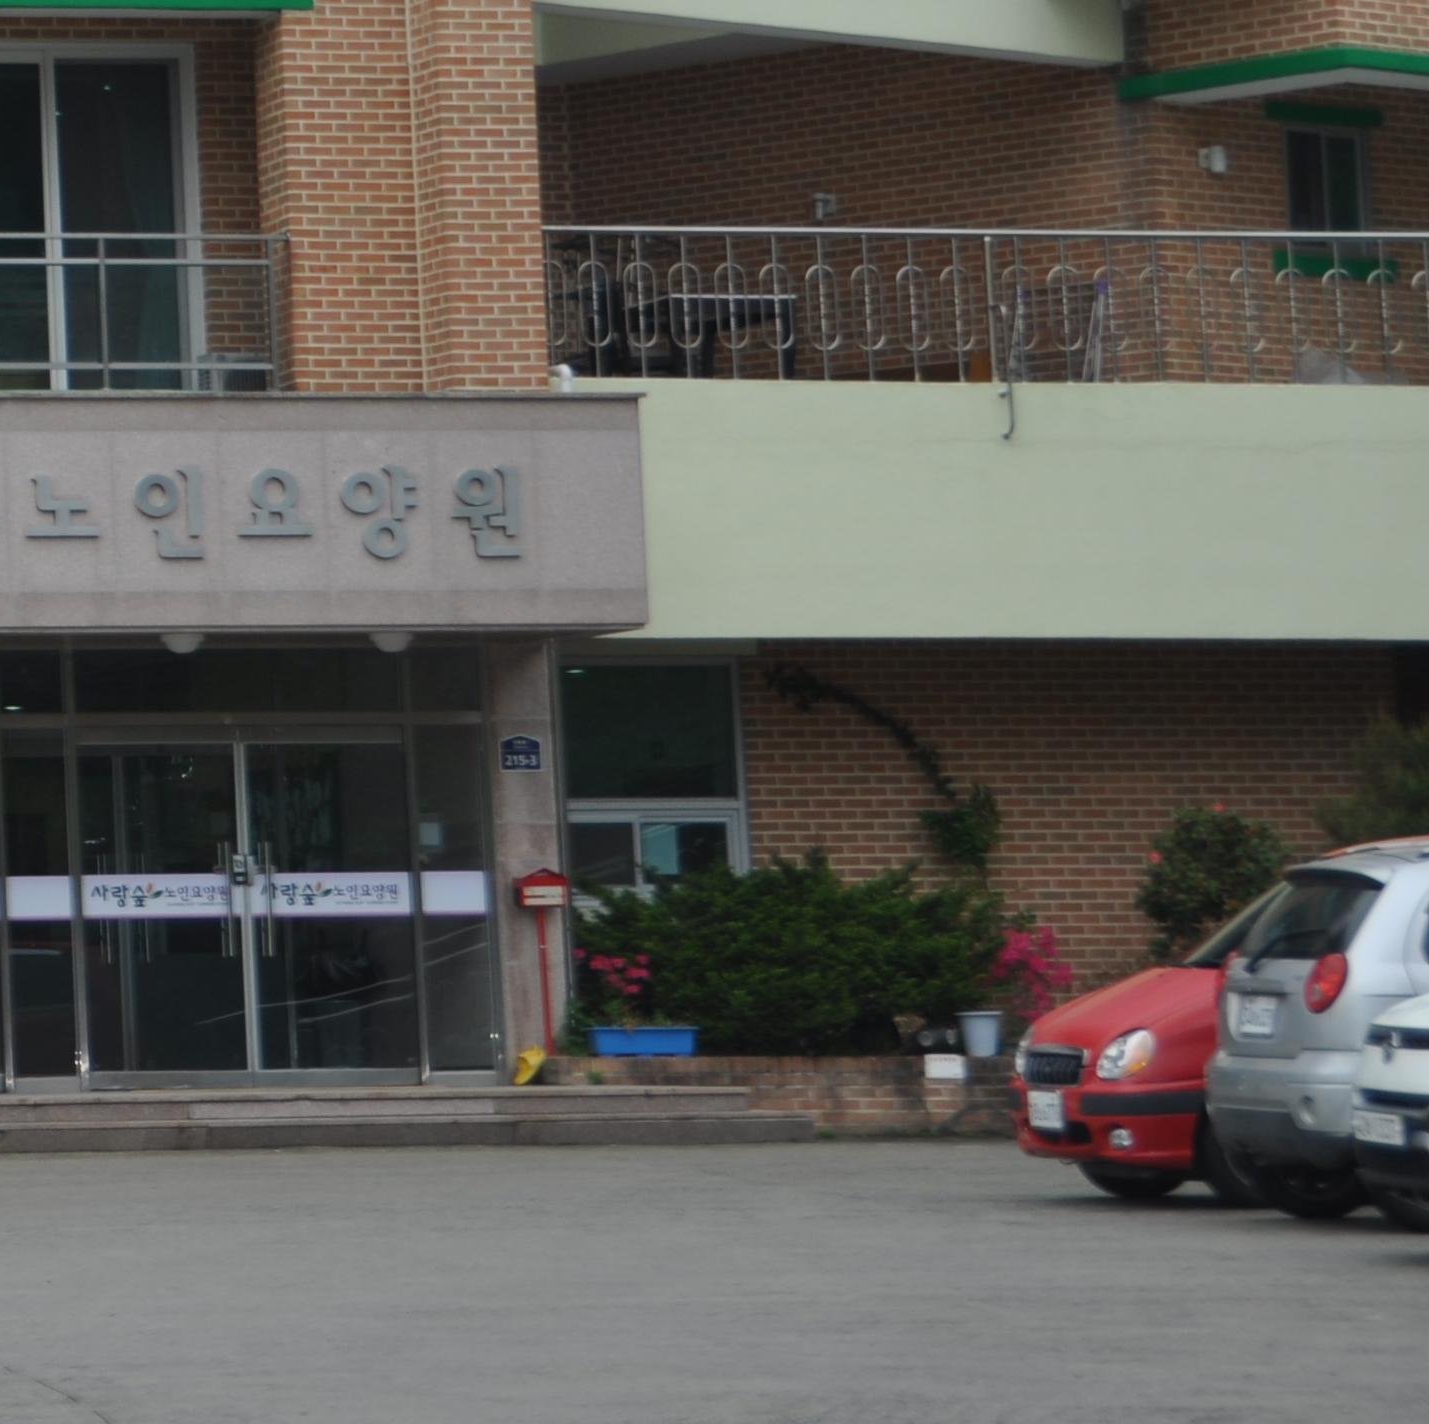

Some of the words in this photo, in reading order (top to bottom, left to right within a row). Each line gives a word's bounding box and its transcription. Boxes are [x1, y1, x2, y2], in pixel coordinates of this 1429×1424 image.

[504, 754, 538, 767] 215-3
[91, 883, 147, 908] 사랑숲
[164, 885, 230, 902] 노인요양원
[333, 883, 398, 901] 노인요양원
